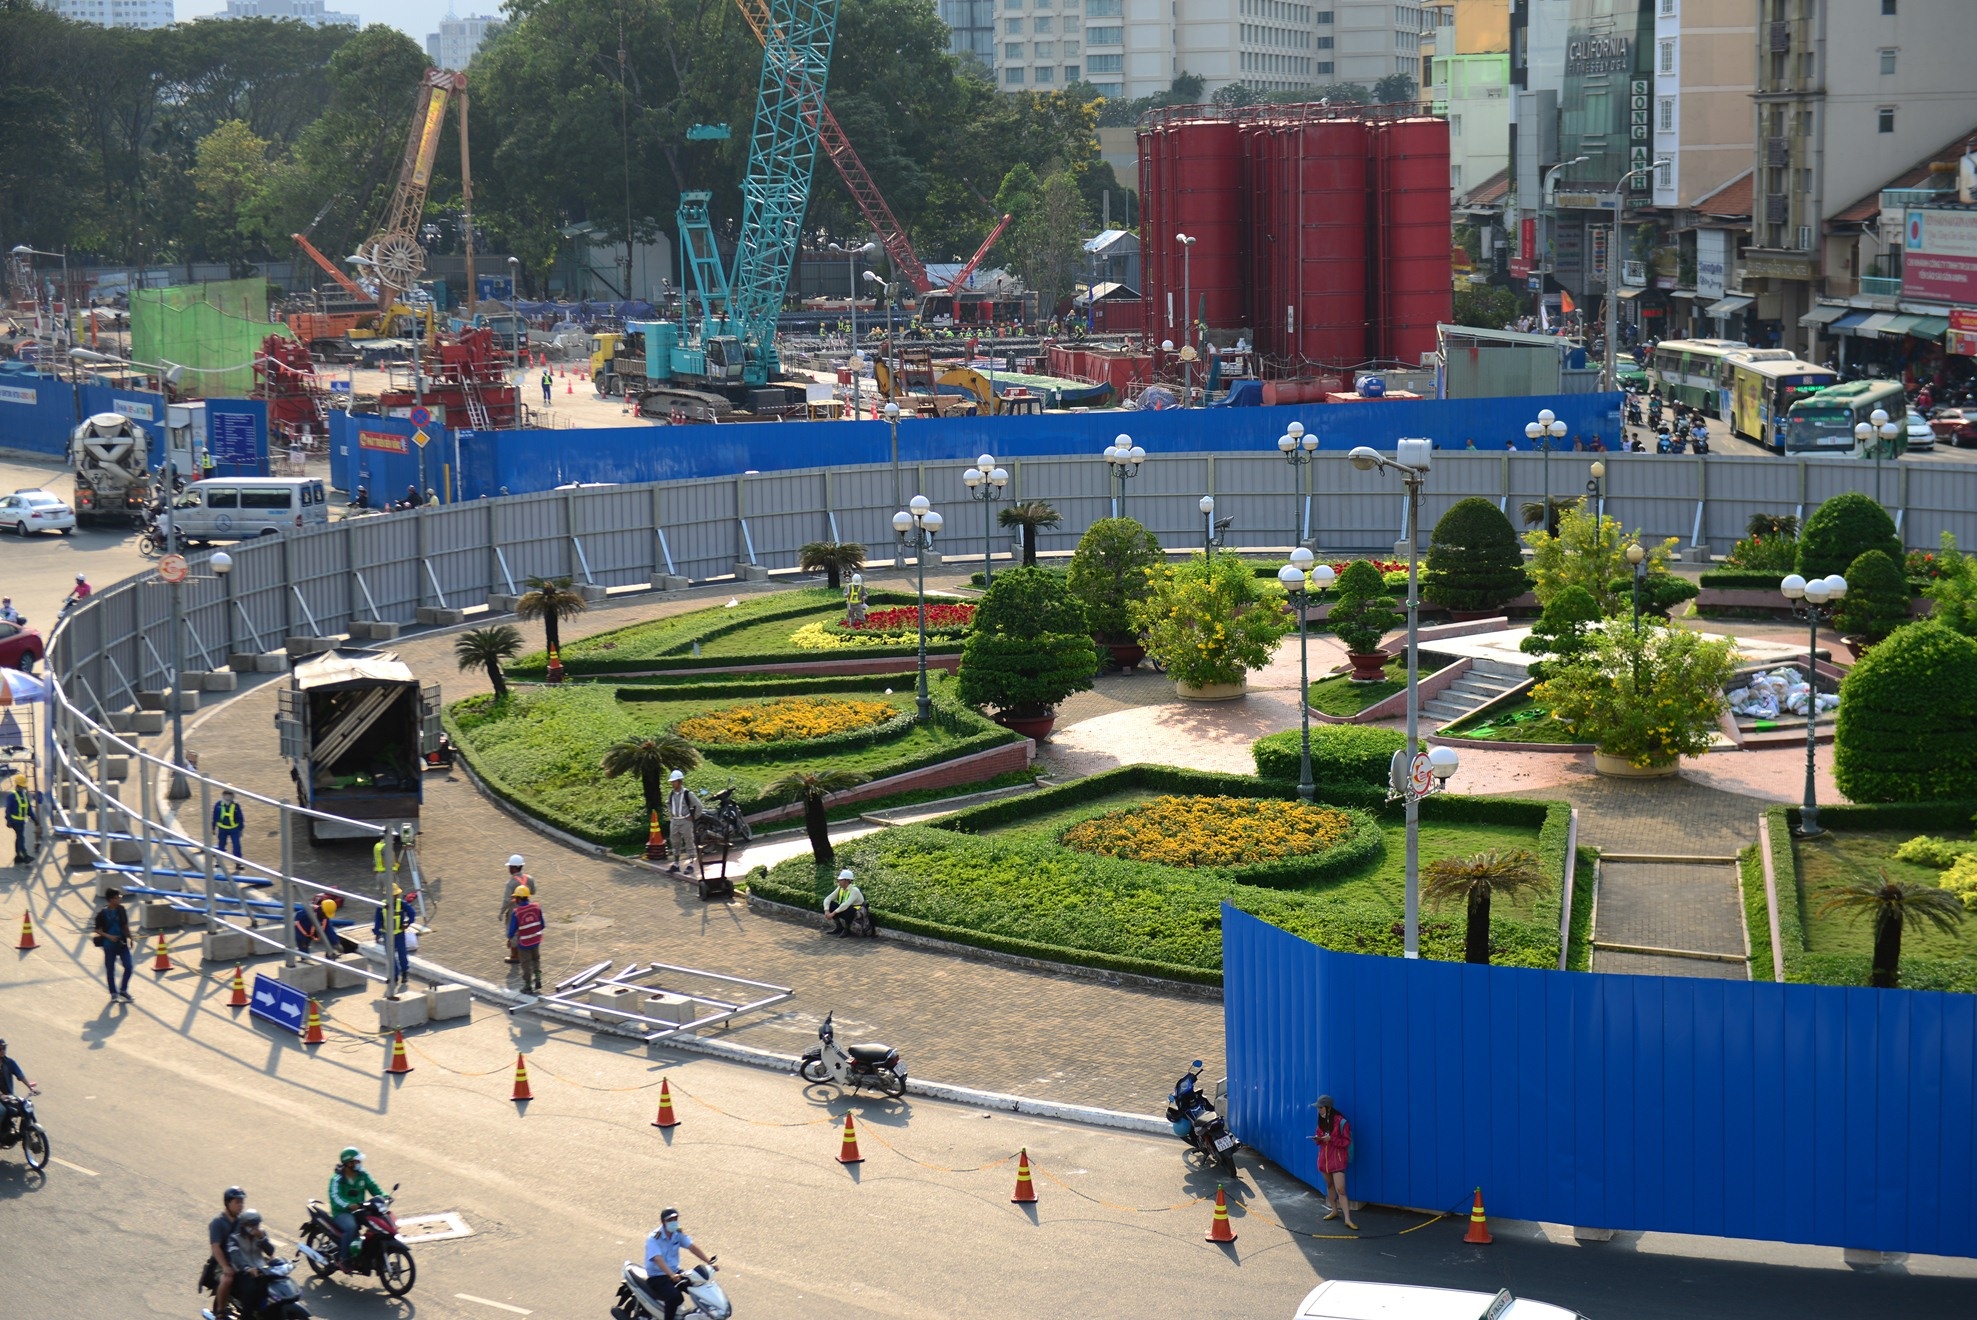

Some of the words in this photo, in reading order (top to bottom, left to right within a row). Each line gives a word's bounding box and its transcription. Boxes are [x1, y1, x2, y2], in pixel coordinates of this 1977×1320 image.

[1569, 38, 1627, 60] CALIFORNIA
[1634, 81, 1645, 139] SONG
[1633, 147, 1645, 189] ANH
